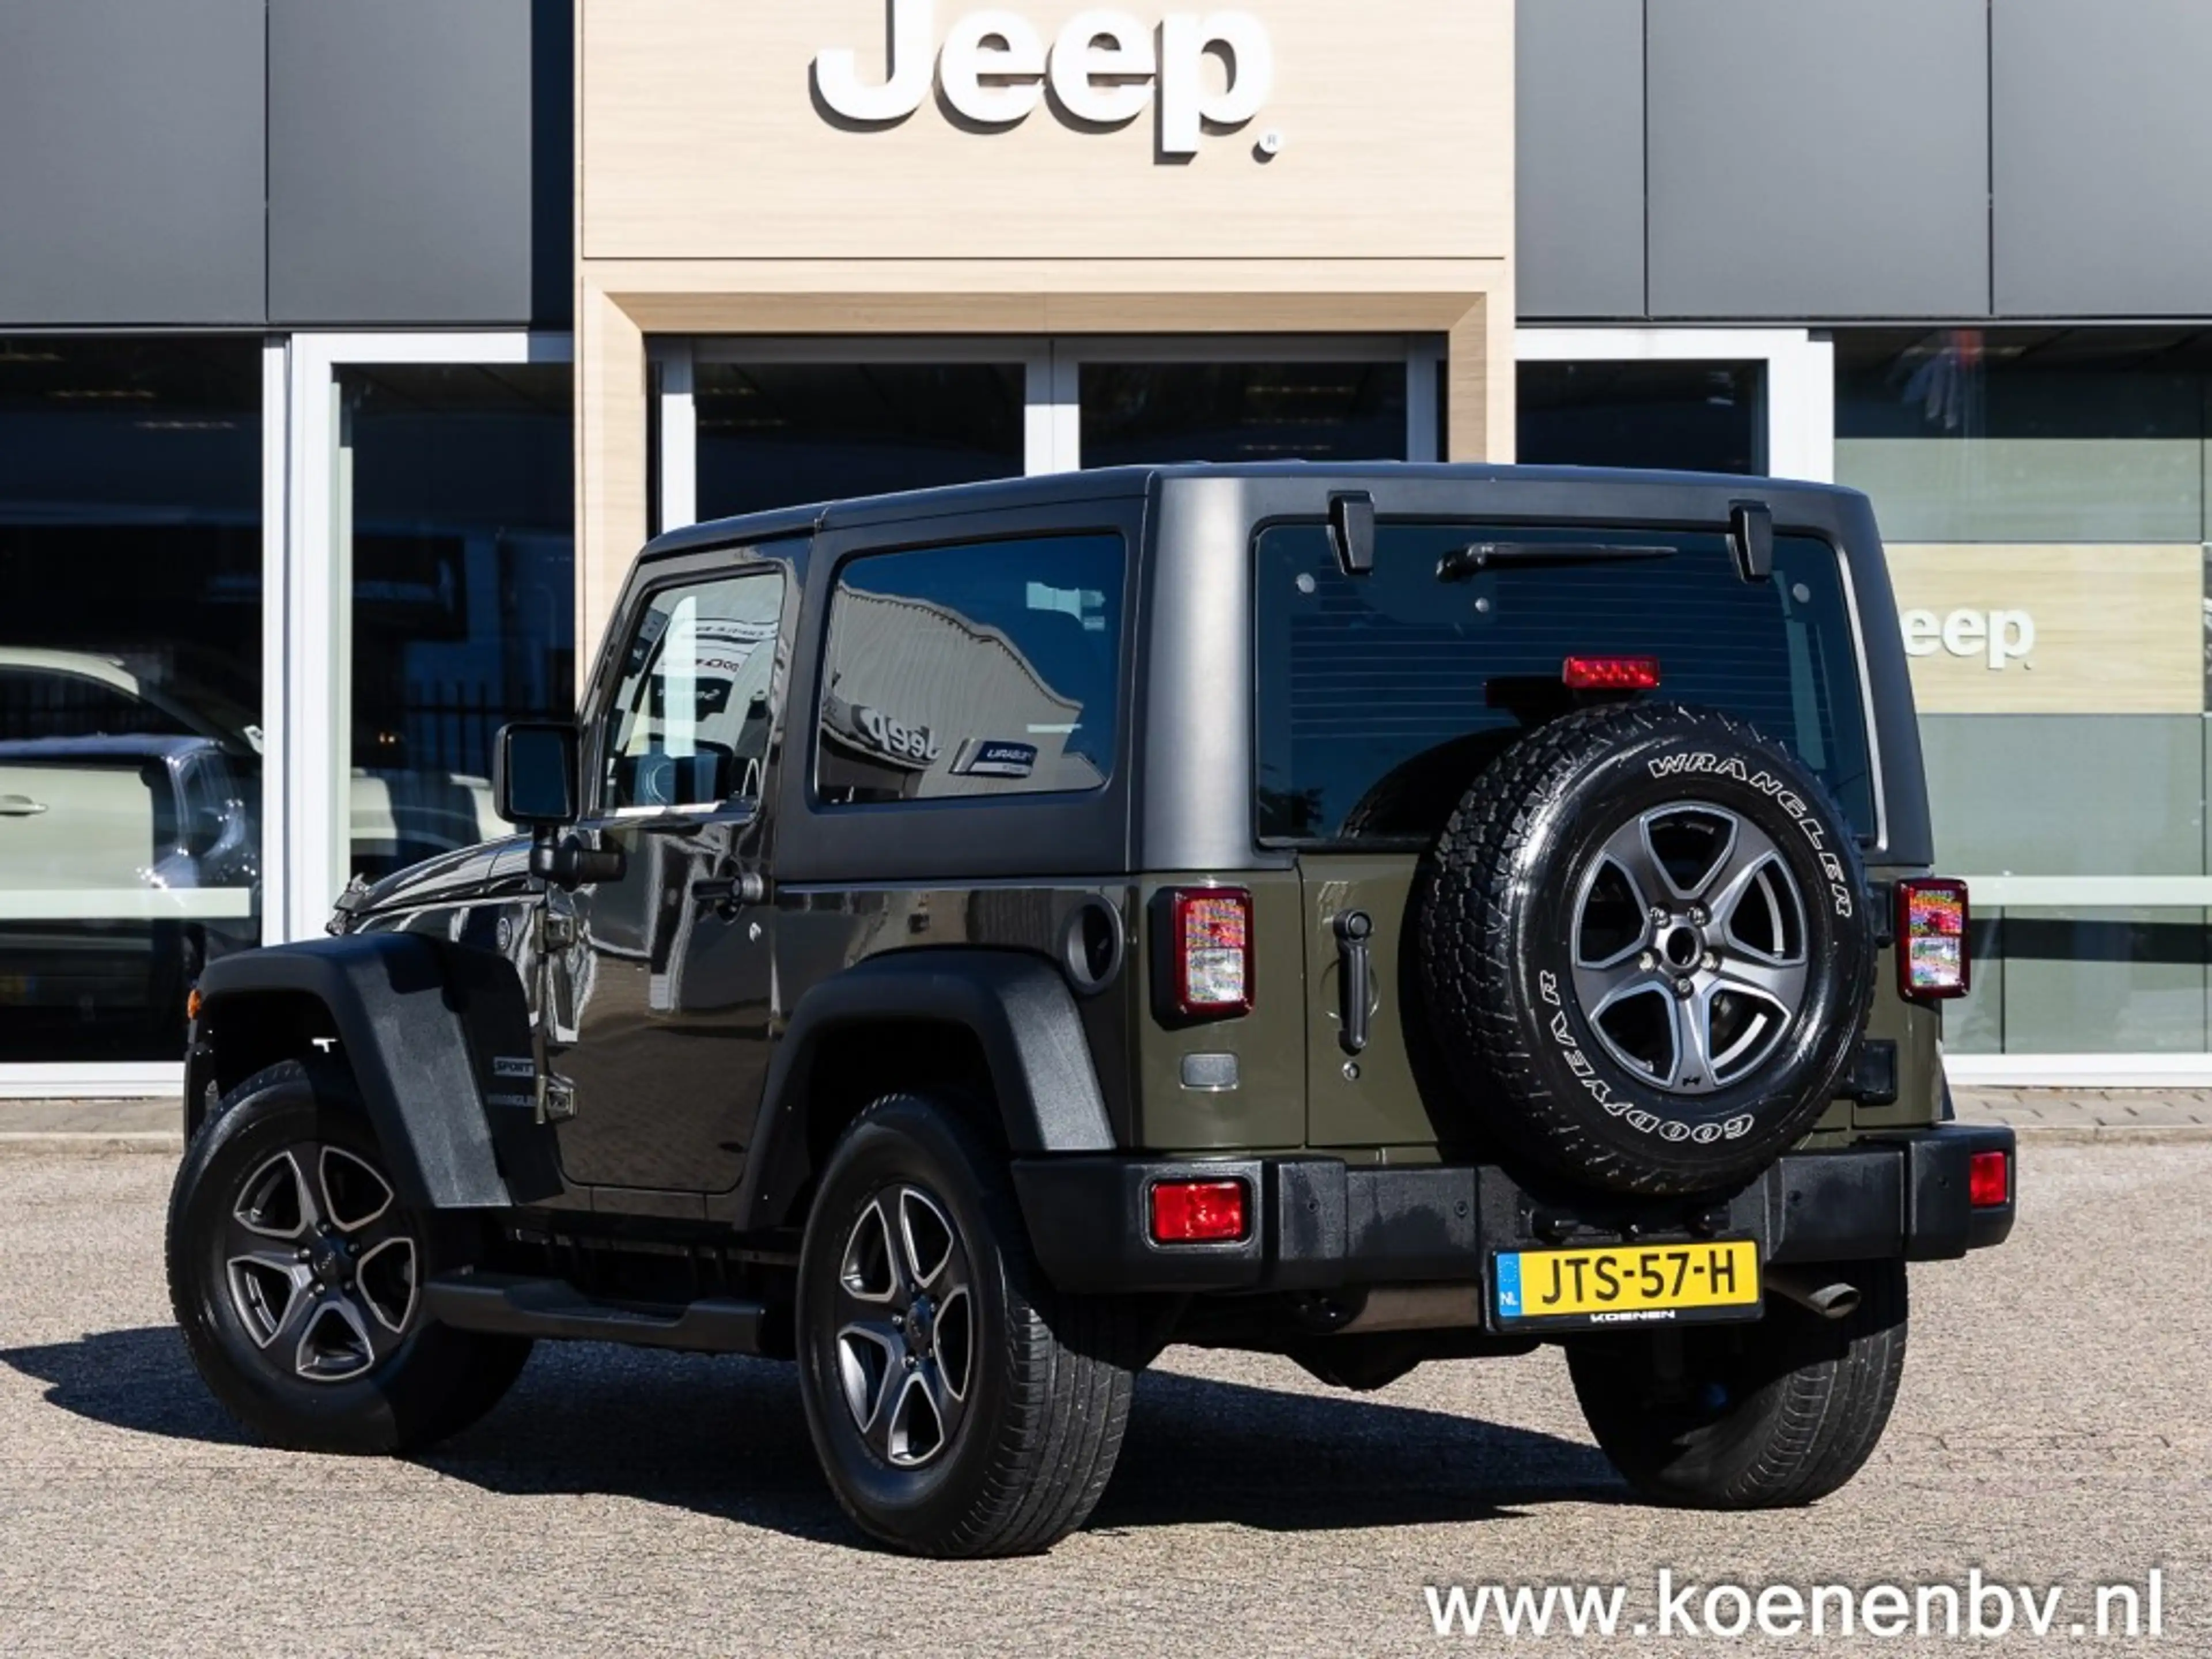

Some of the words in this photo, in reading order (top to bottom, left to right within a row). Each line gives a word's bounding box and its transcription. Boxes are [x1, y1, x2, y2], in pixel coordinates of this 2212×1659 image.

[812, 0, 1275, 157] Jeep
[1901, 608, 2035, 670] eep
[1647, 751, 1853, 918] WRANGLER
[1539, 969, 1755, 1143] GOODYEAR
[1499, 1291, 1520, 1306] NL
[1541, 1249, 1736, 1305] JTS-57-H
[1589, 1309, 1676, 1323] KOENEN
